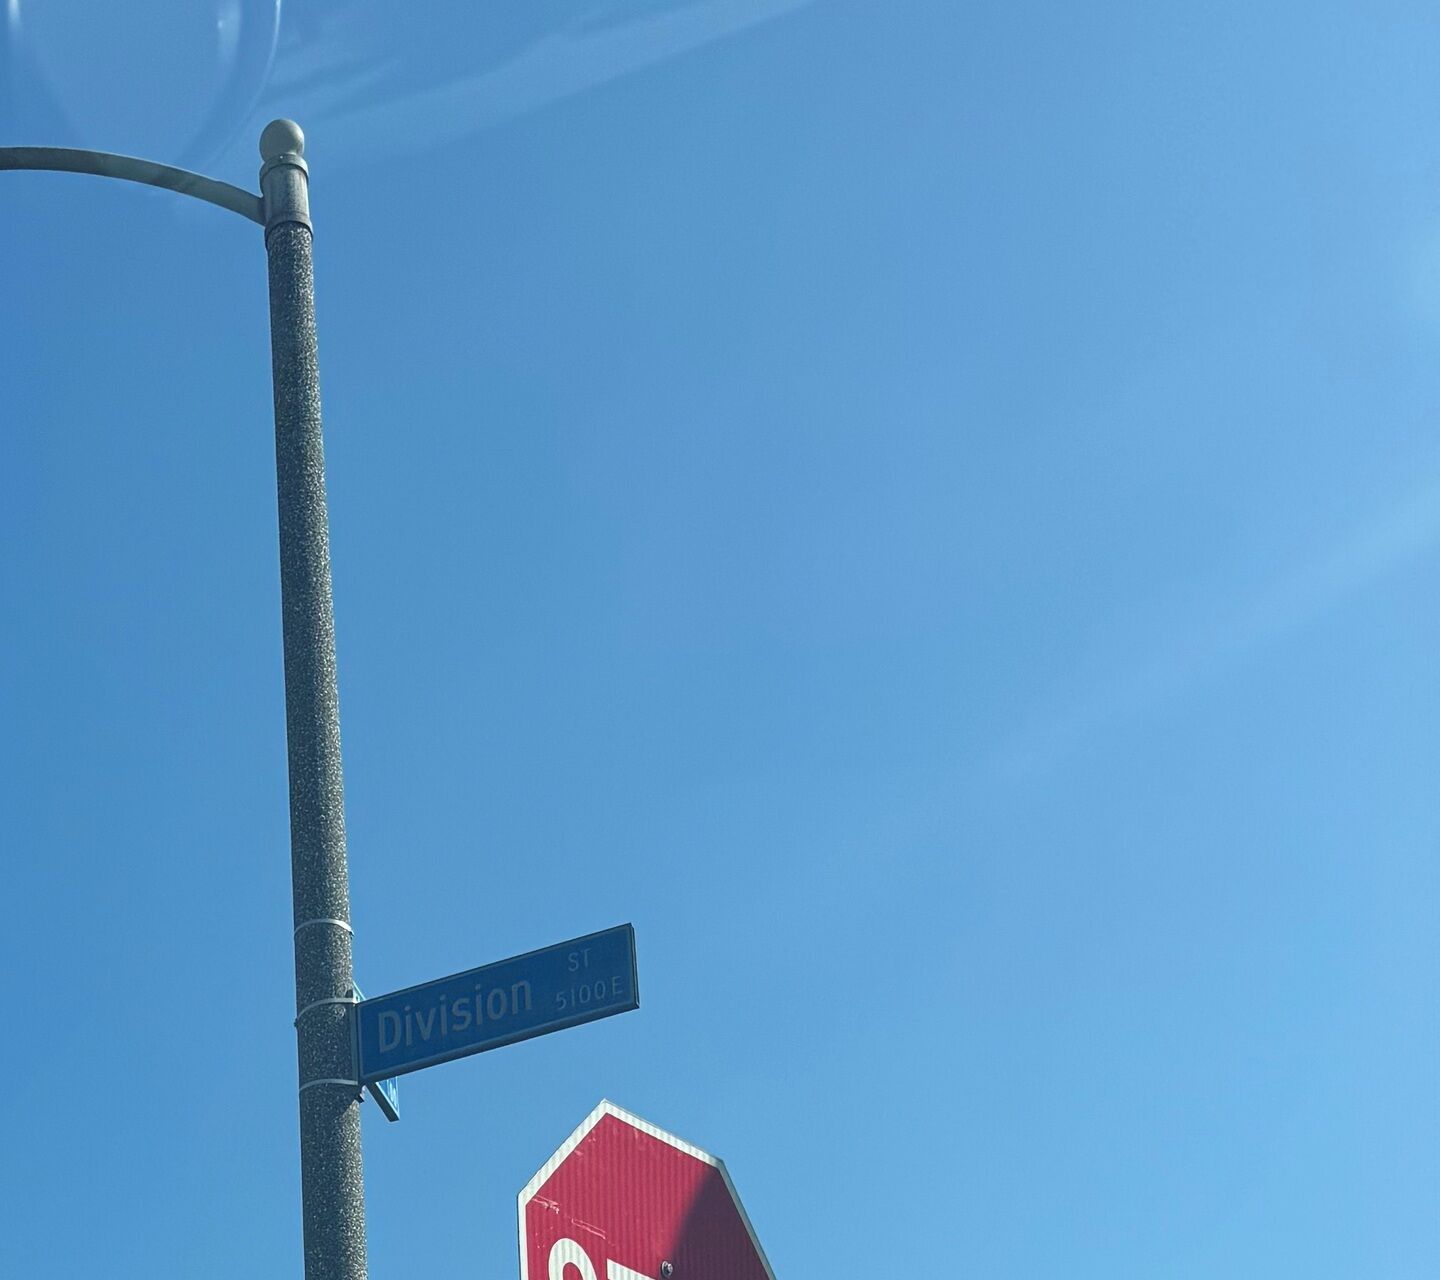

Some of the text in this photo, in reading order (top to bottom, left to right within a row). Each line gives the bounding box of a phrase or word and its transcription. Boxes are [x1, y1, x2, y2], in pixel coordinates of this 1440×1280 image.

[378, 949, 591, 1054] Division ST
[556, 976, 624, 1010] 5100 E
